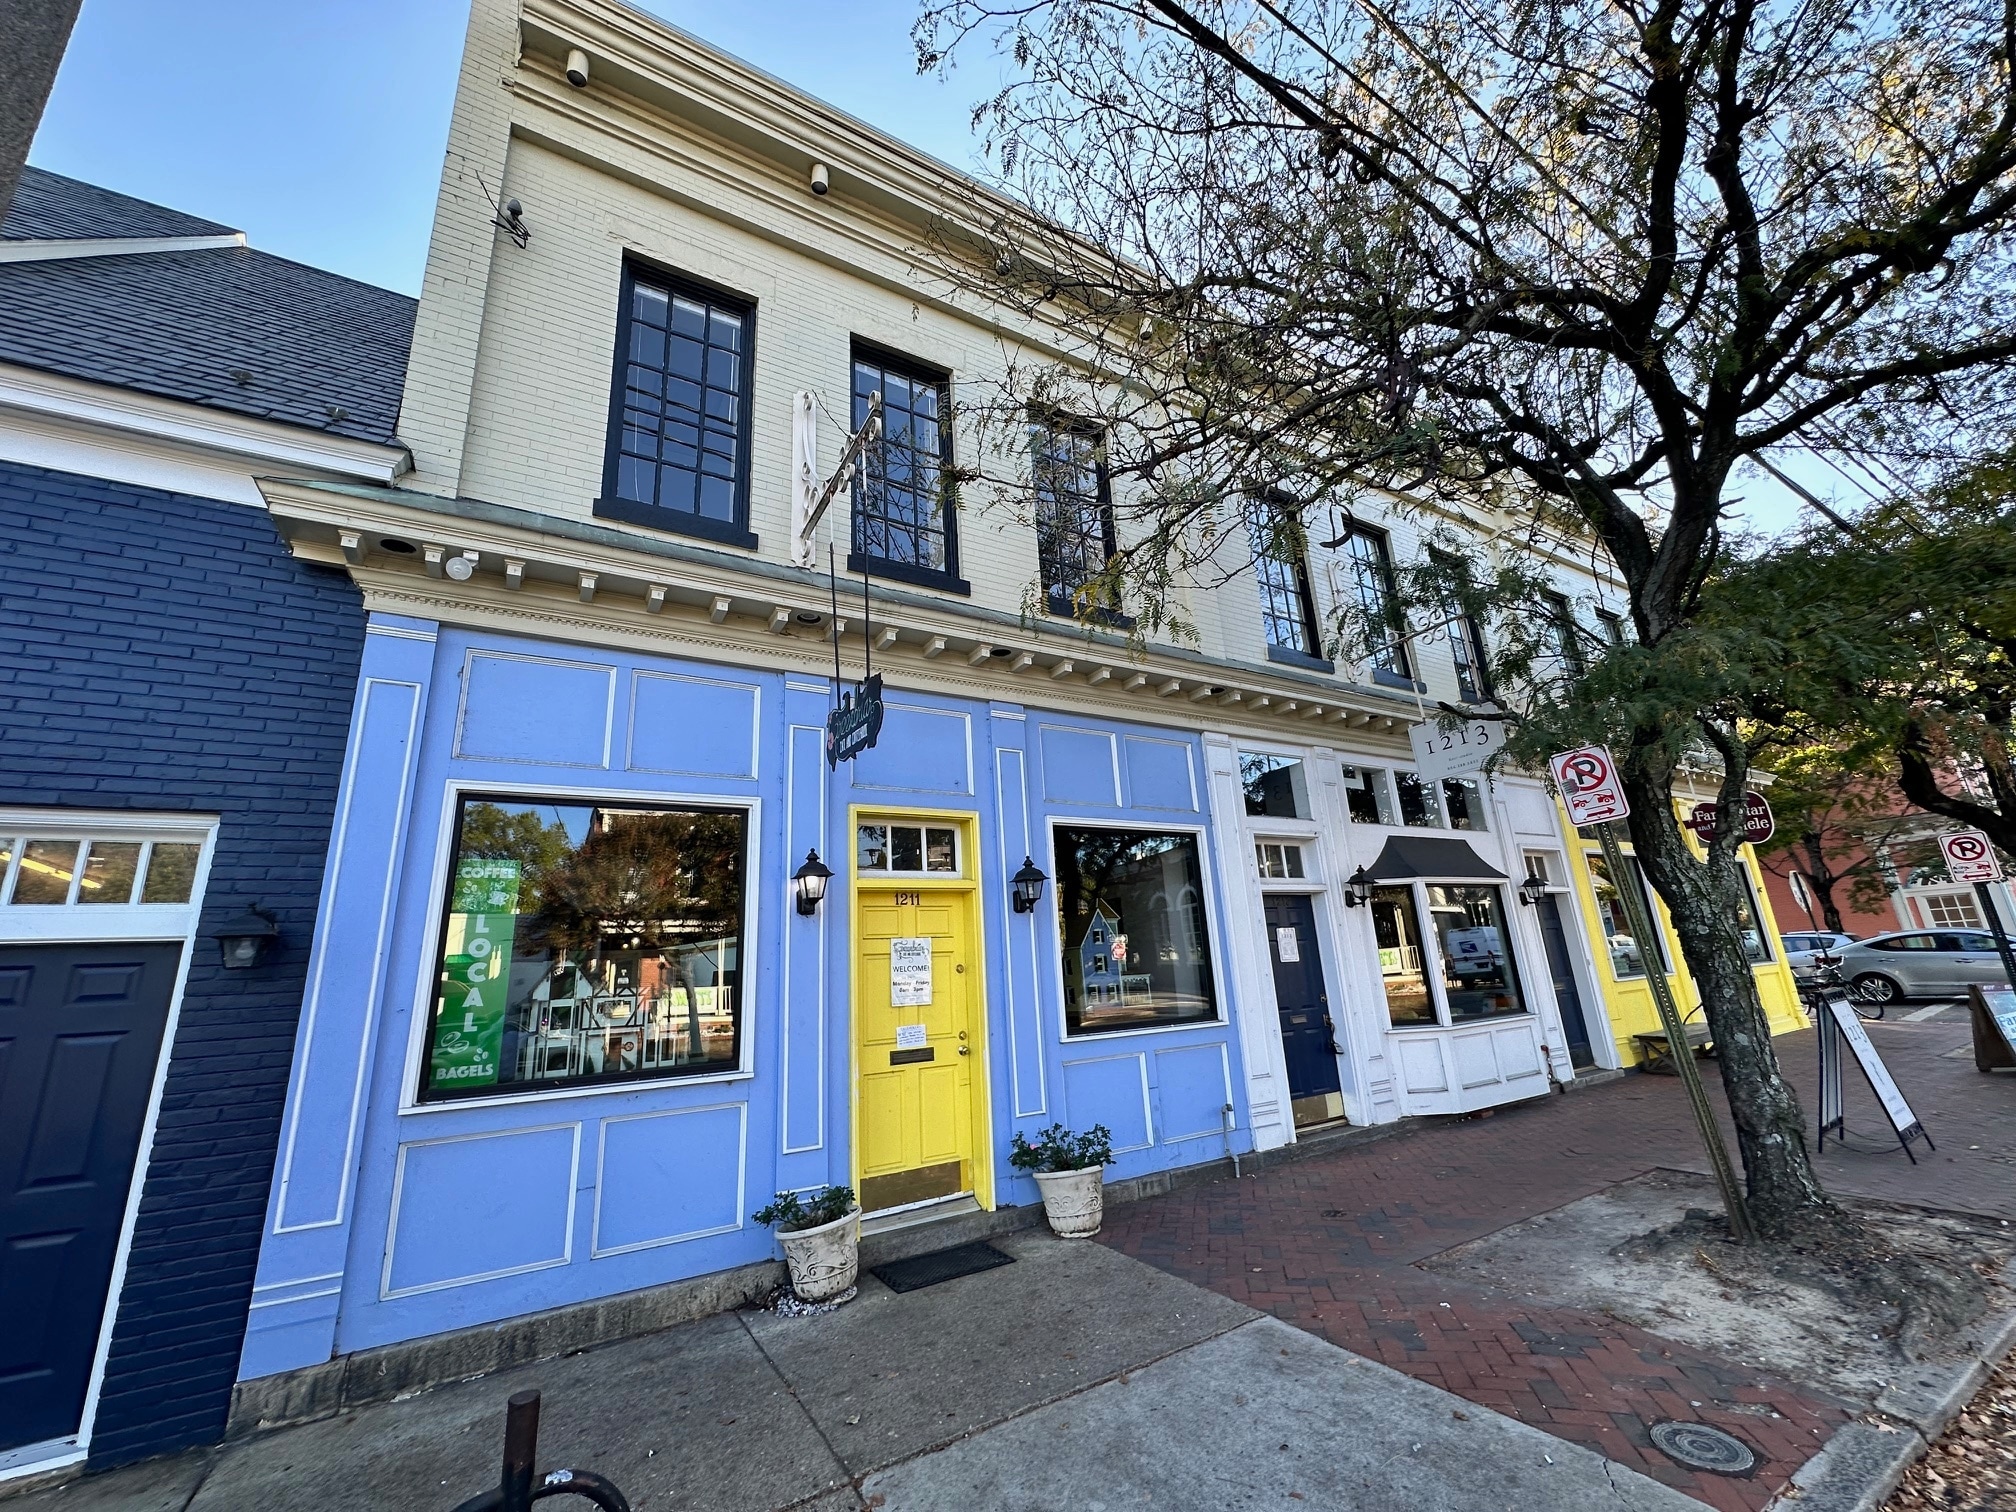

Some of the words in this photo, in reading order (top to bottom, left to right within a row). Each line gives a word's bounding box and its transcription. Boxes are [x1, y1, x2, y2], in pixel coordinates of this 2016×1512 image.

[1425, 725, 1489, 755] 1213
[461, 867, 516, 878] COFFEE
[894, 892, 921, 906] 1211
[462, 915, 491, 1033] LOCAL
[892, 965, 930, 973] WELCOME!
[436, 1064, 494, 1080] BAGELS
